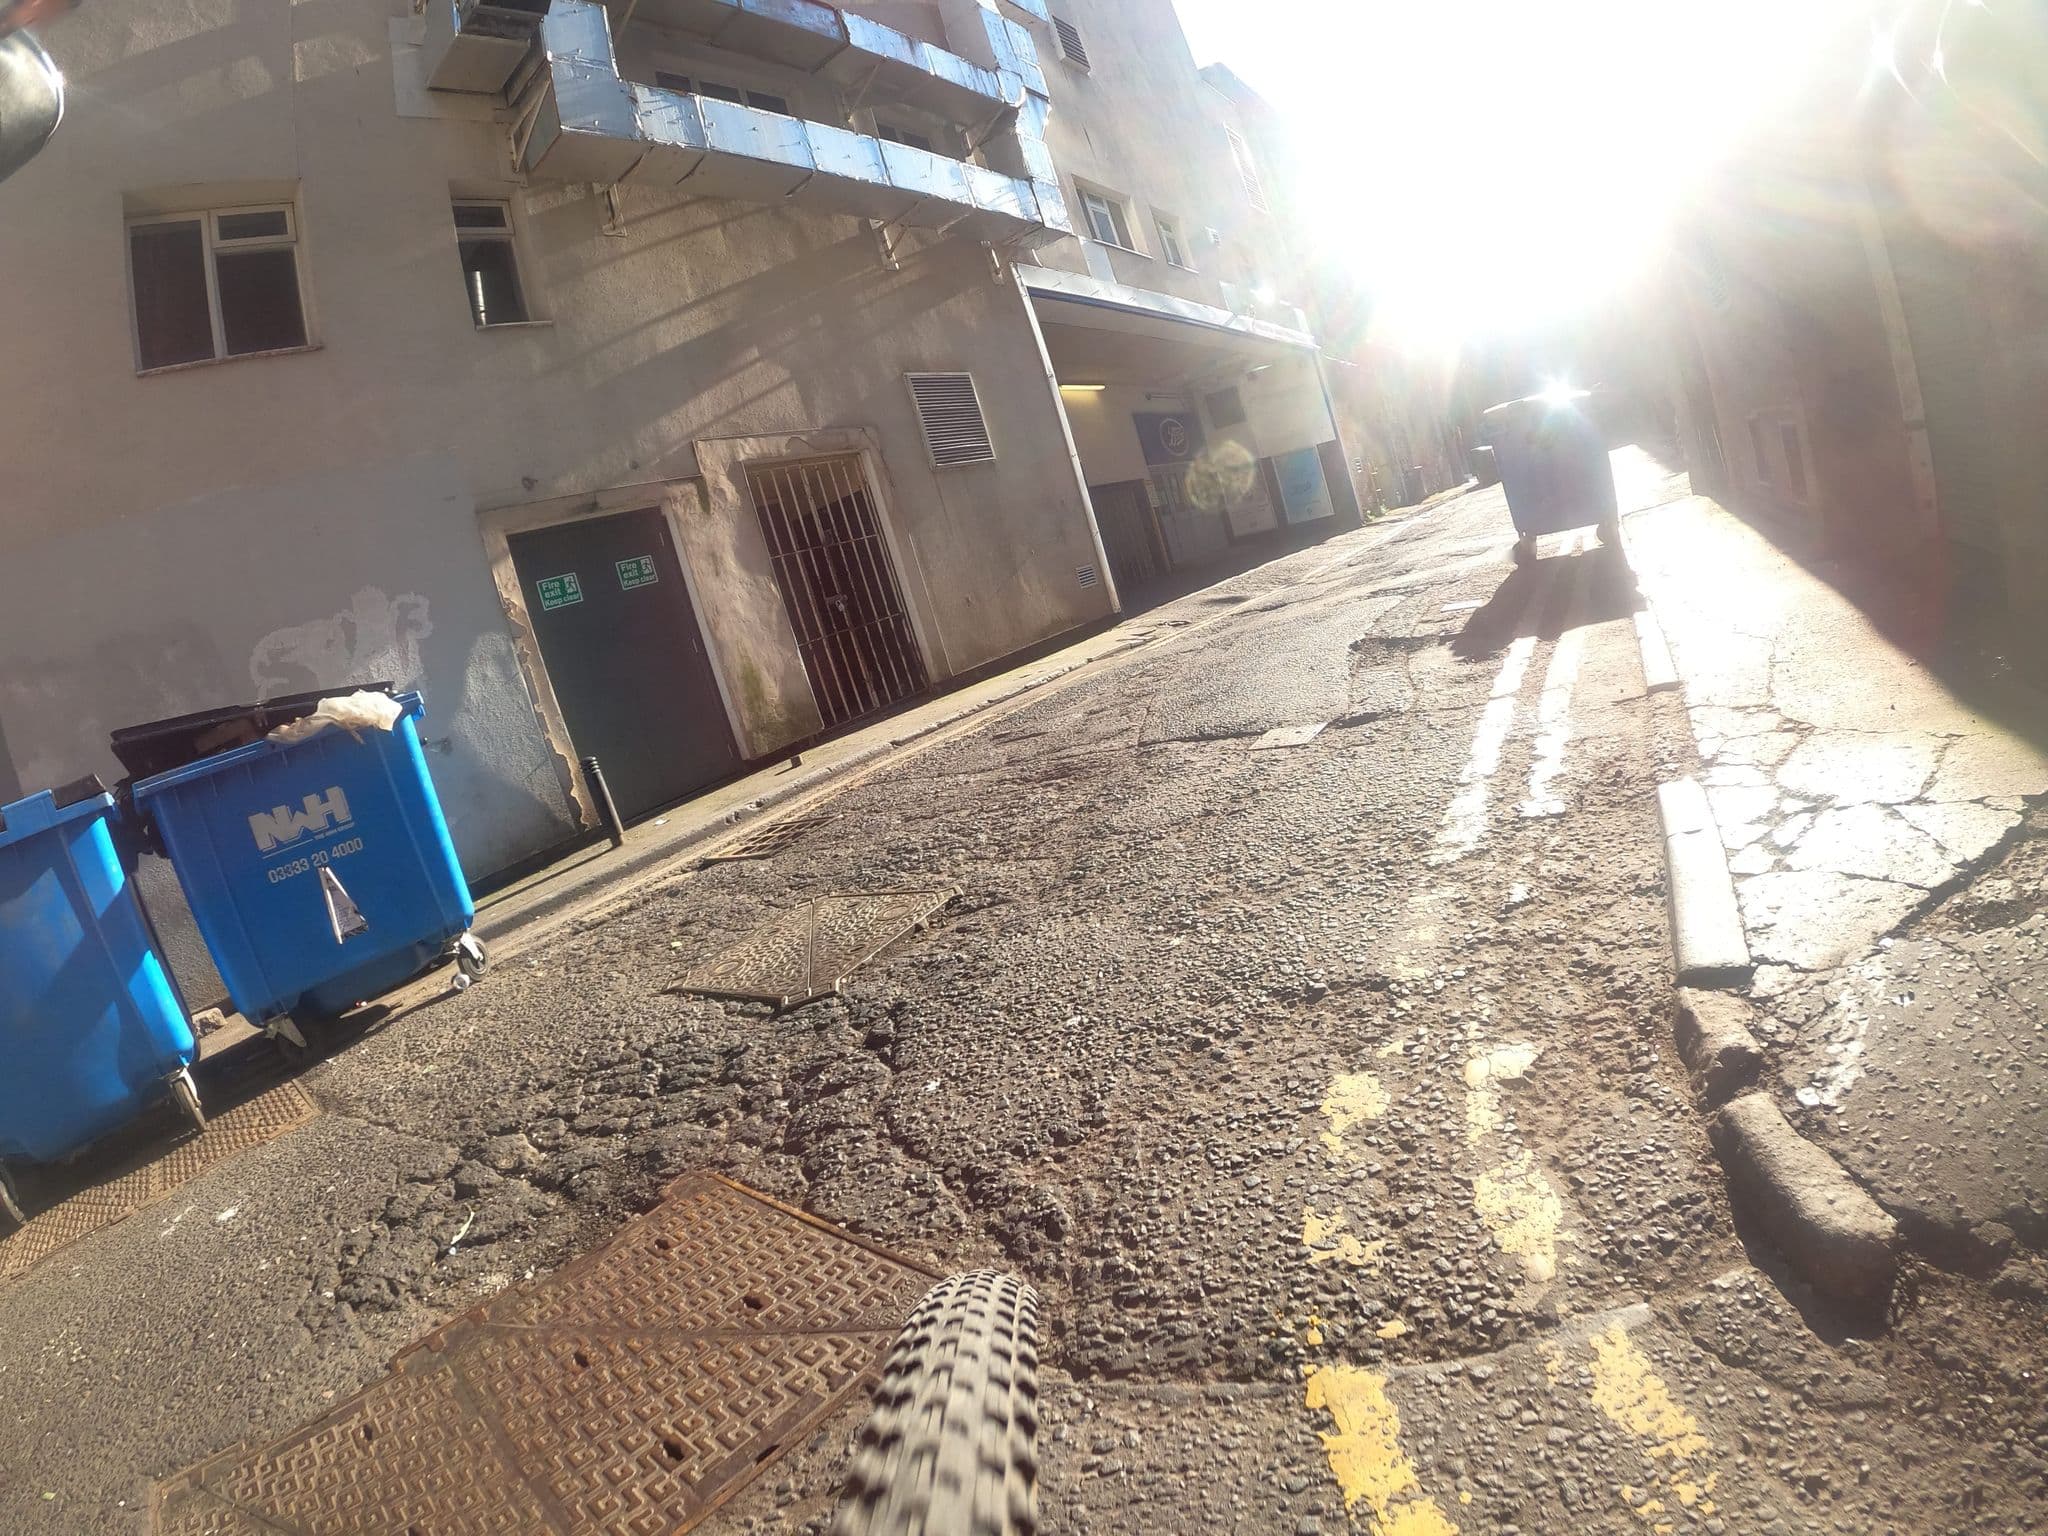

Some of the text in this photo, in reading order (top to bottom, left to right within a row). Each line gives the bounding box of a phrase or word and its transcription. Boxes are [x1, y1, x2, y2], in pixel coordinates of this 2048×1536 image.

[620, 562, 637, 571] Fire
[623, 569, 639, 578] exit
[541, 581, 560, 591] Fire
[624, 578, 640, 587] Keep
[544, 588, 562, 598] exit
[545, 592, 580, 607] Keep clear
[247, 785, 352, 852] NWH
[267, 837, 363, 884] 03333 20 4000
